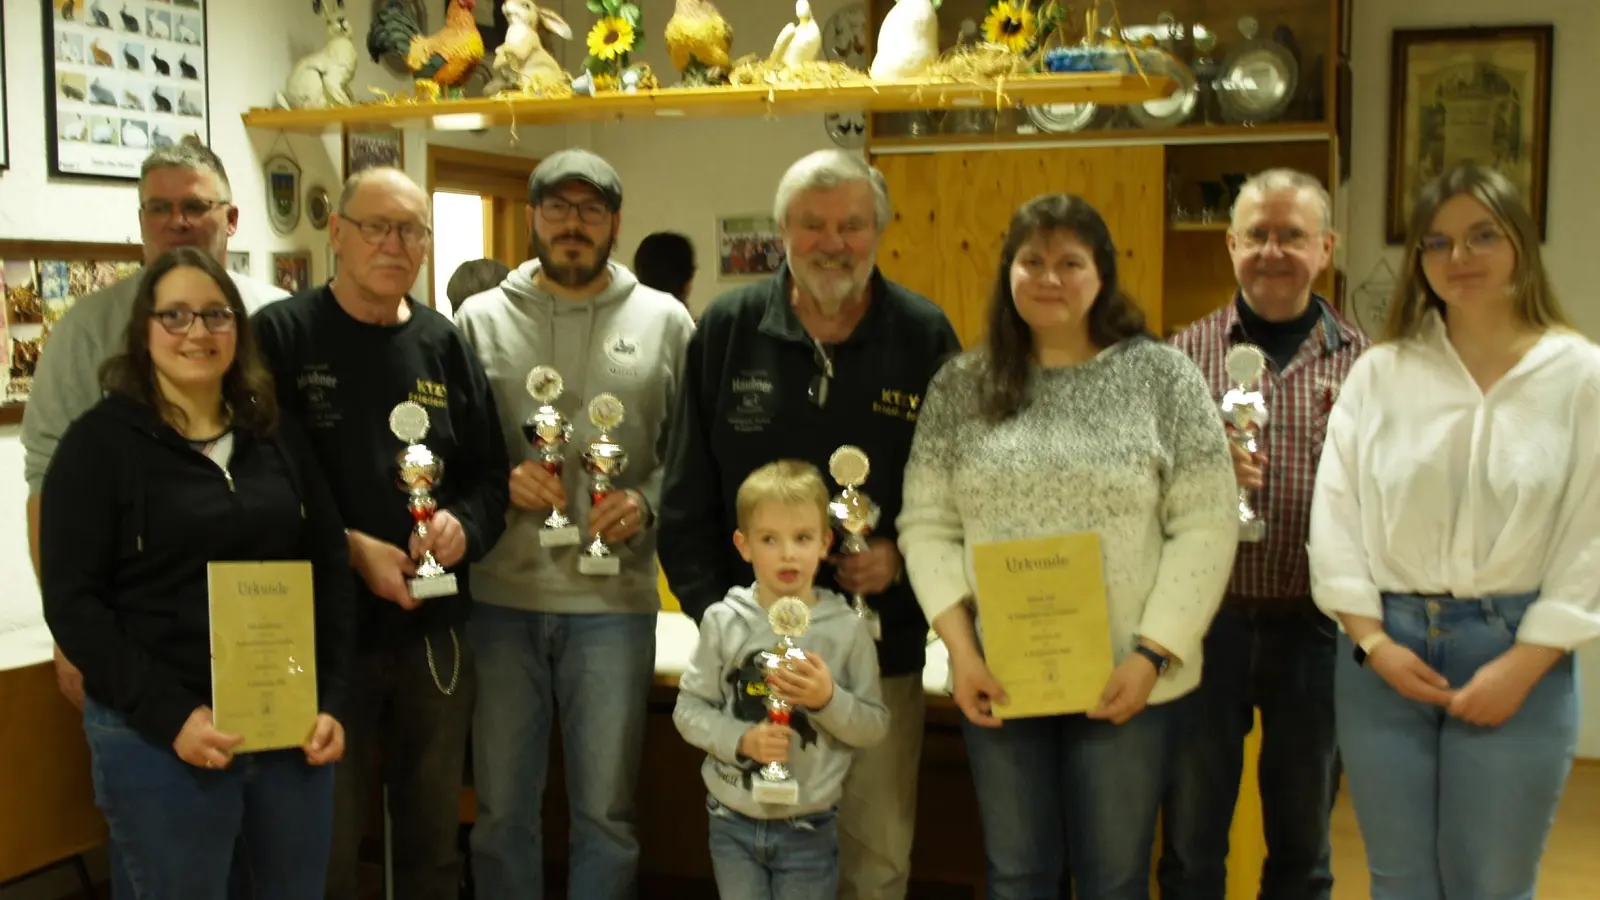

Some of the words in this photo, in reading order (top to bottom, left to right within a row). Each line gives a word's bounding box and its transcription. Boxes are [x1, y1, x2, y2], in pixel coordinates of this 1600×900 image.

[882, 388, 920, 410] KTV
[1004, 552, 1069, 574] Urkunde
[236, 581, 290, 597] Urkunde
